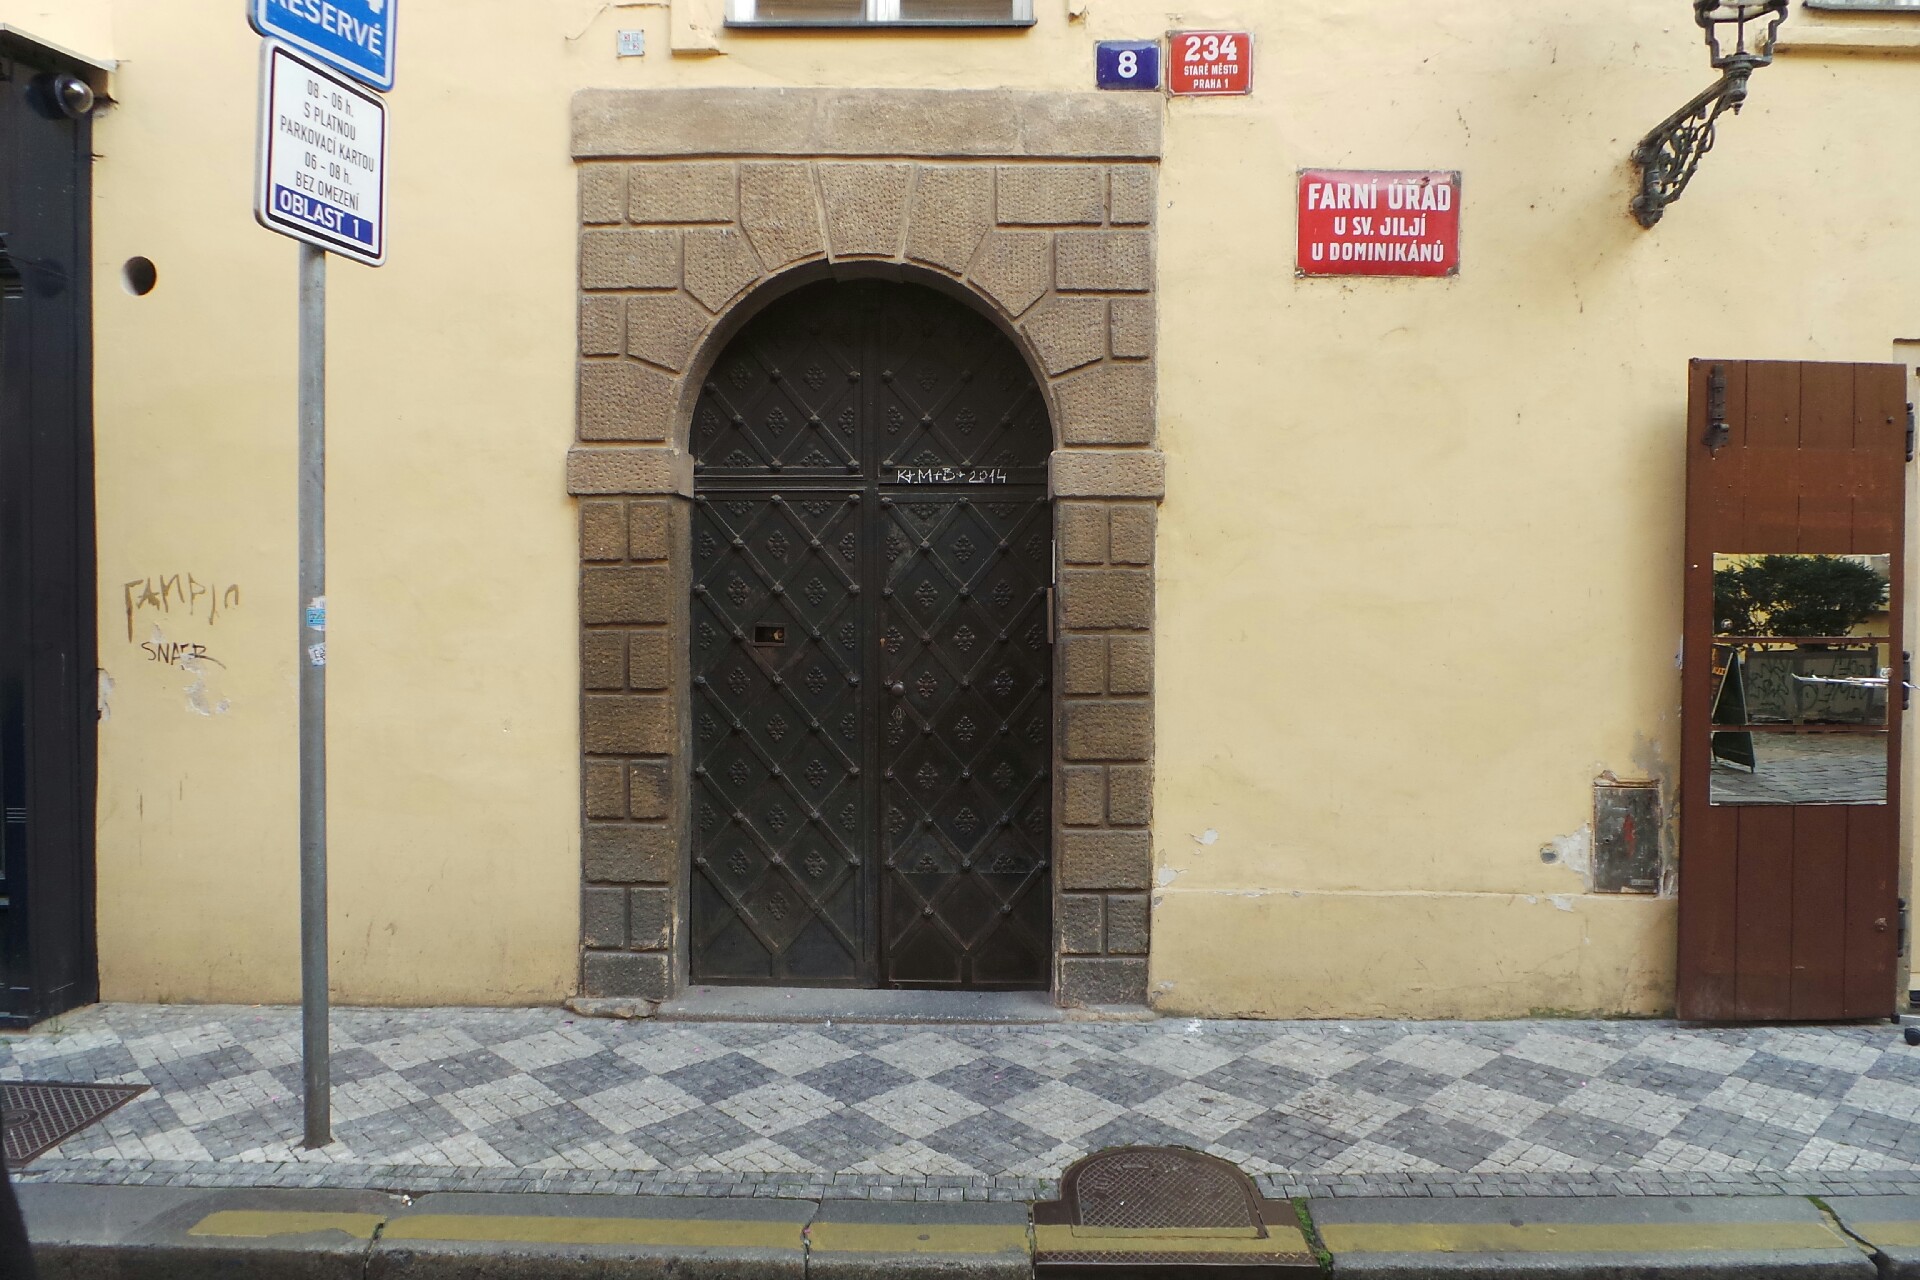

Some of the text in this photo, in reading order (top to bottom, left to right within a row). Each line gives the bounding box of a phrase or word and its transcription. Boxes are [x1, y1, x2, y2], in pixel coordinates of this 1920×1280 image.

[269, 0, 383, 57] ESERVÉ
[1184, 34, 1238, 62] 234
[1117, 50, 1138, 79] 8
[1183, 62, 1238, 76] STARÉ MĚSTO
[306, 79, 319, 99] 08
[331, 92, 343, 111] 06
[1193, 78, 1229, 89] PRAHA 1
[303, 101, 357, 141] S PLATNOU
[280, 114, 375, 173] PARKOVACÍ KARTOU
[304, 151, 317, 170] 06
[329, 162, 341, 180] 08
[295, 170, 360, 212] BEZ OMEZENÍ
[1308, 179, 1451, 211] FARNÍ ÚŘAD
[280, 189, 360, 239] OBLAST 1
[1334, 213, 1427, 237] U SV. JILJÍ
[1311, 240, 1444, 263] U DOMINIKÁNŮ
